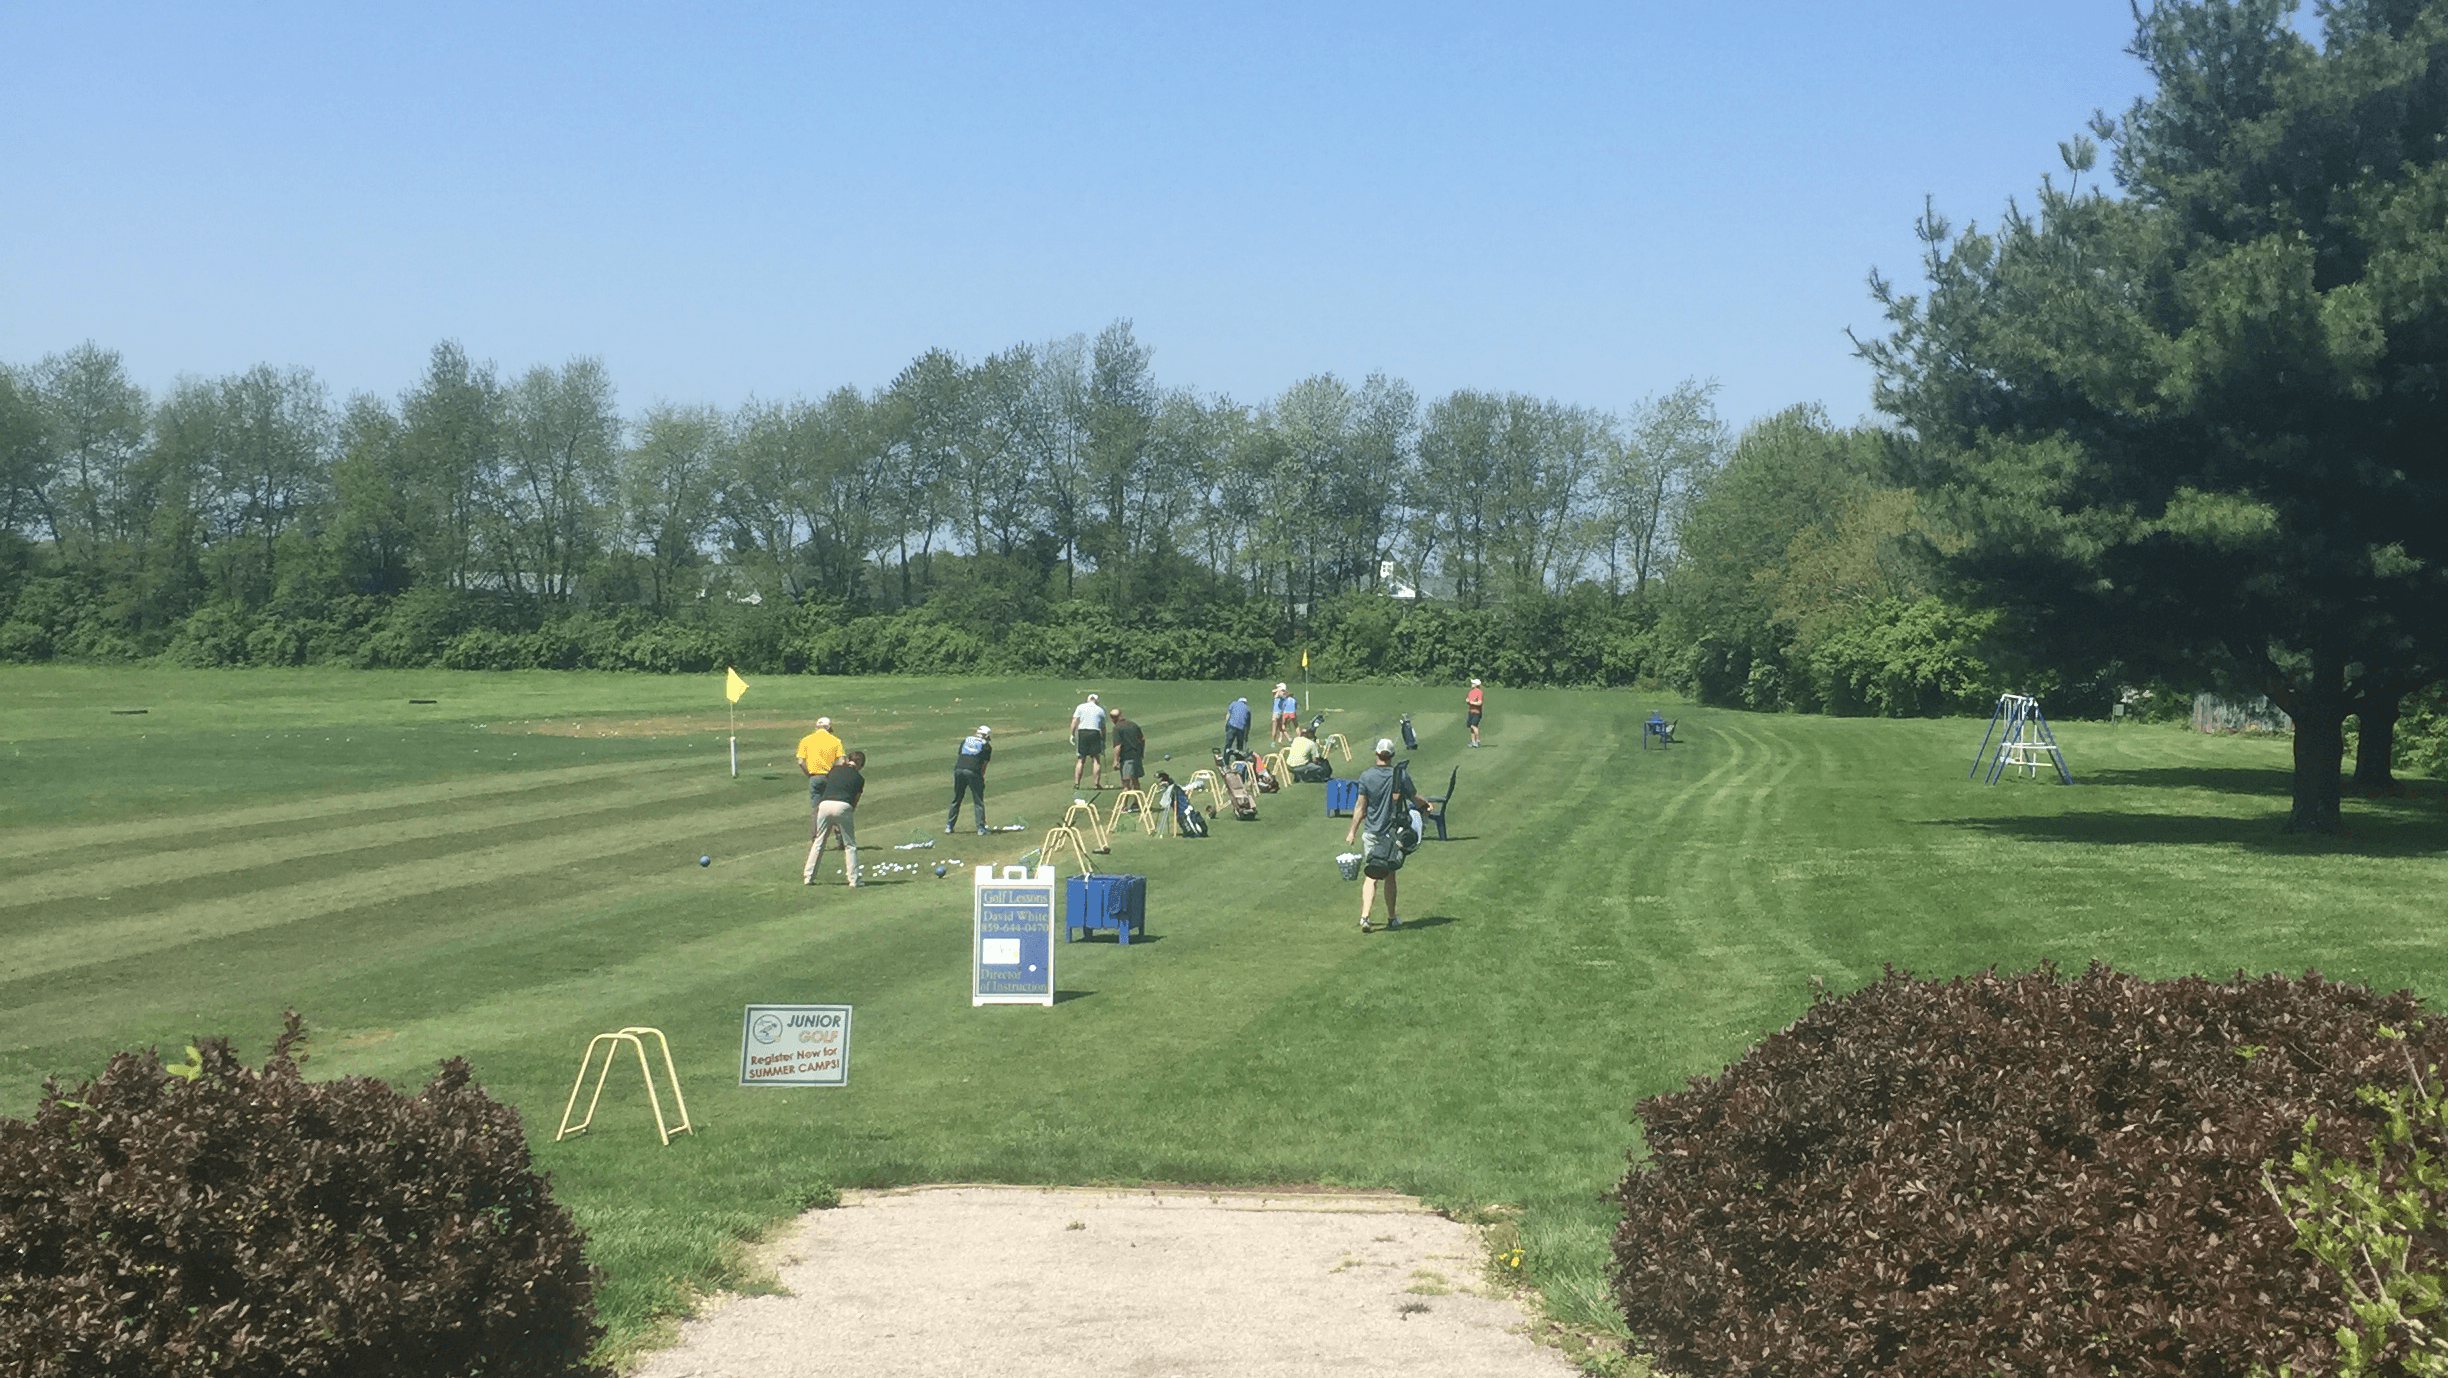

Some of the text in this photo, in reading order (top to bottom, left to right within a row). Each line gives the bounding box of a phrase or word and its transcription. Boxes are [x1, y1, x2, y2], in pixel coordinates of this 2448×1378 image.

[984, 891, 1047, 903] Golf Lessons
[983, 910, 1047, 921] David White
[981, 968, 1021, 979] Director
[980, 980, 1048, 992] of Instruction
[787, 1015, 841, 1027] JUNIOR
[799, 1030, 838, 1043] GOLF
[751, 1047, 837, 1066] Register Now for
[749, 1059, 839, 1078] SUMMER CAMPS!
